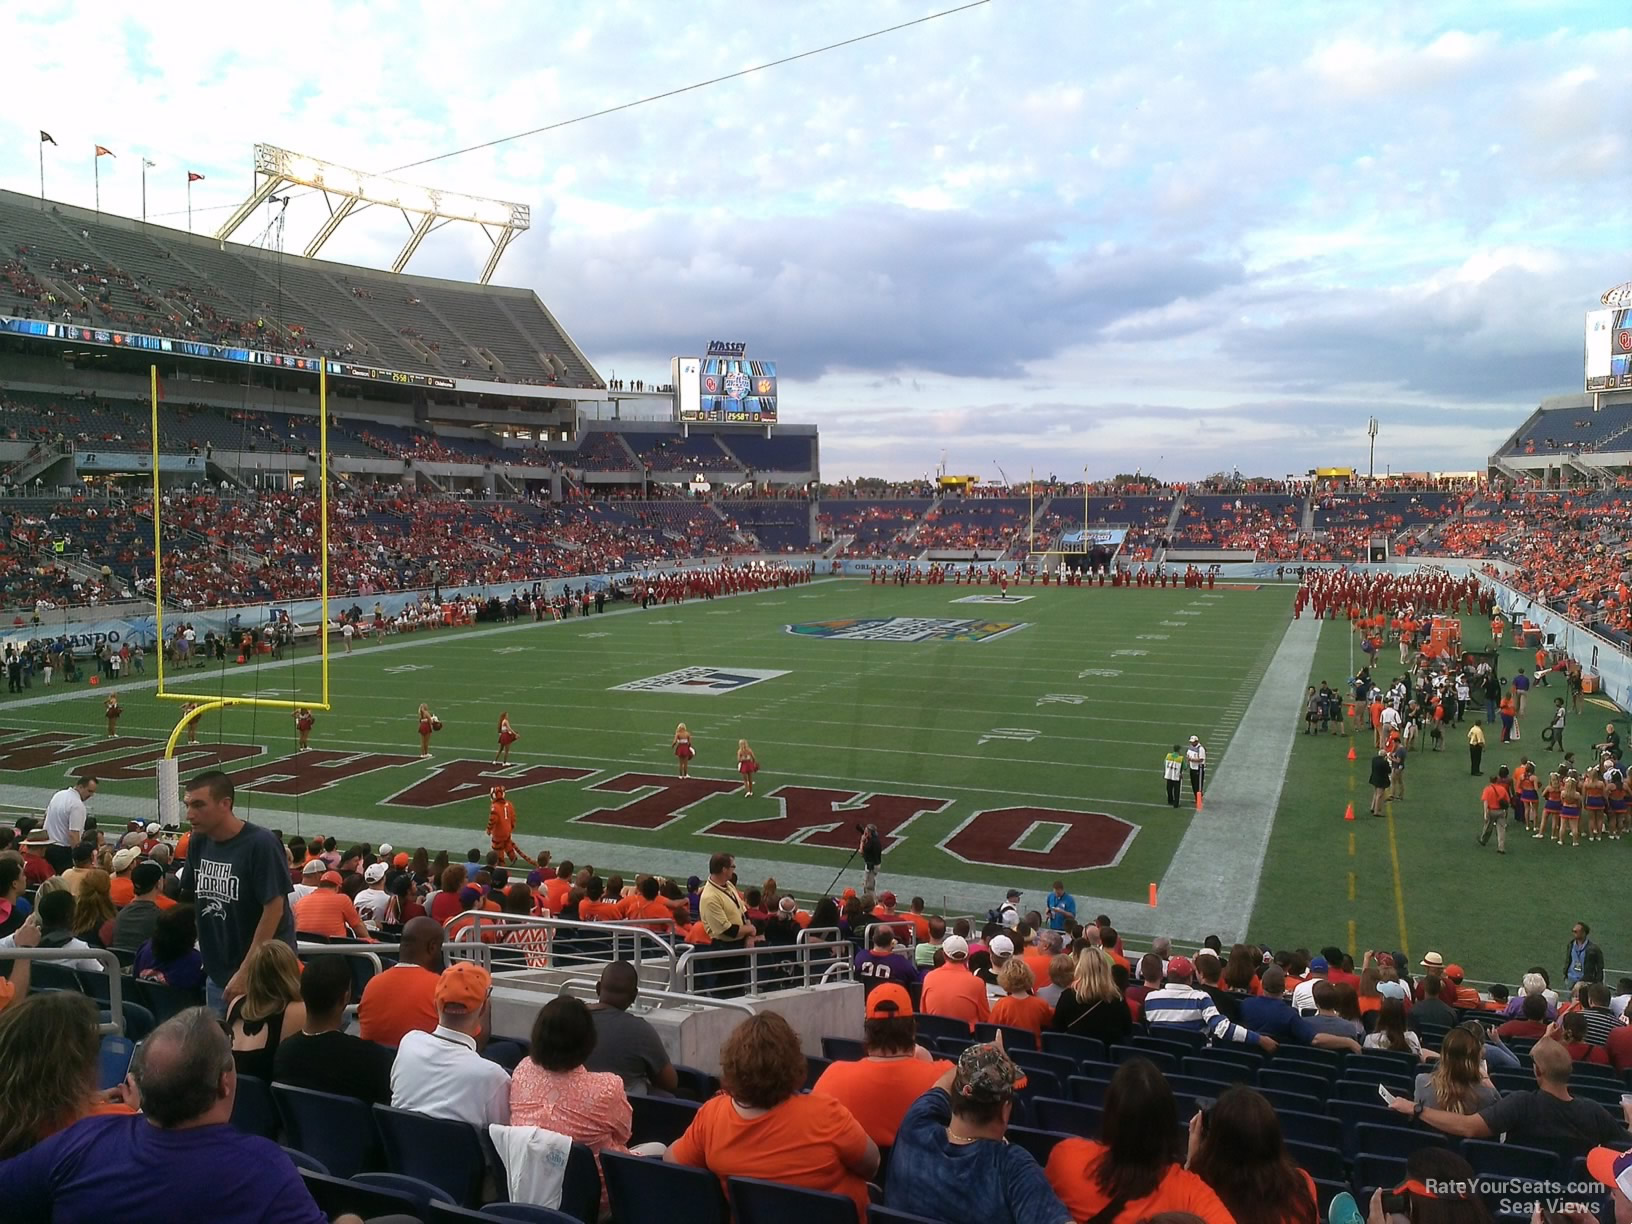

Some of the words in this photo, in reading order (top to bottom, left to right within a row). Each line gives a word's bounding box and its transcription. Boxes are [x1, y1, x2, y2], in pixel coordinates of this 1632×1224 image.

[708, 340, 746, 352] MASSEY
[0, 727, 1142, 873] OKLAHOM
[201, 860, 231, 878] NORTH
